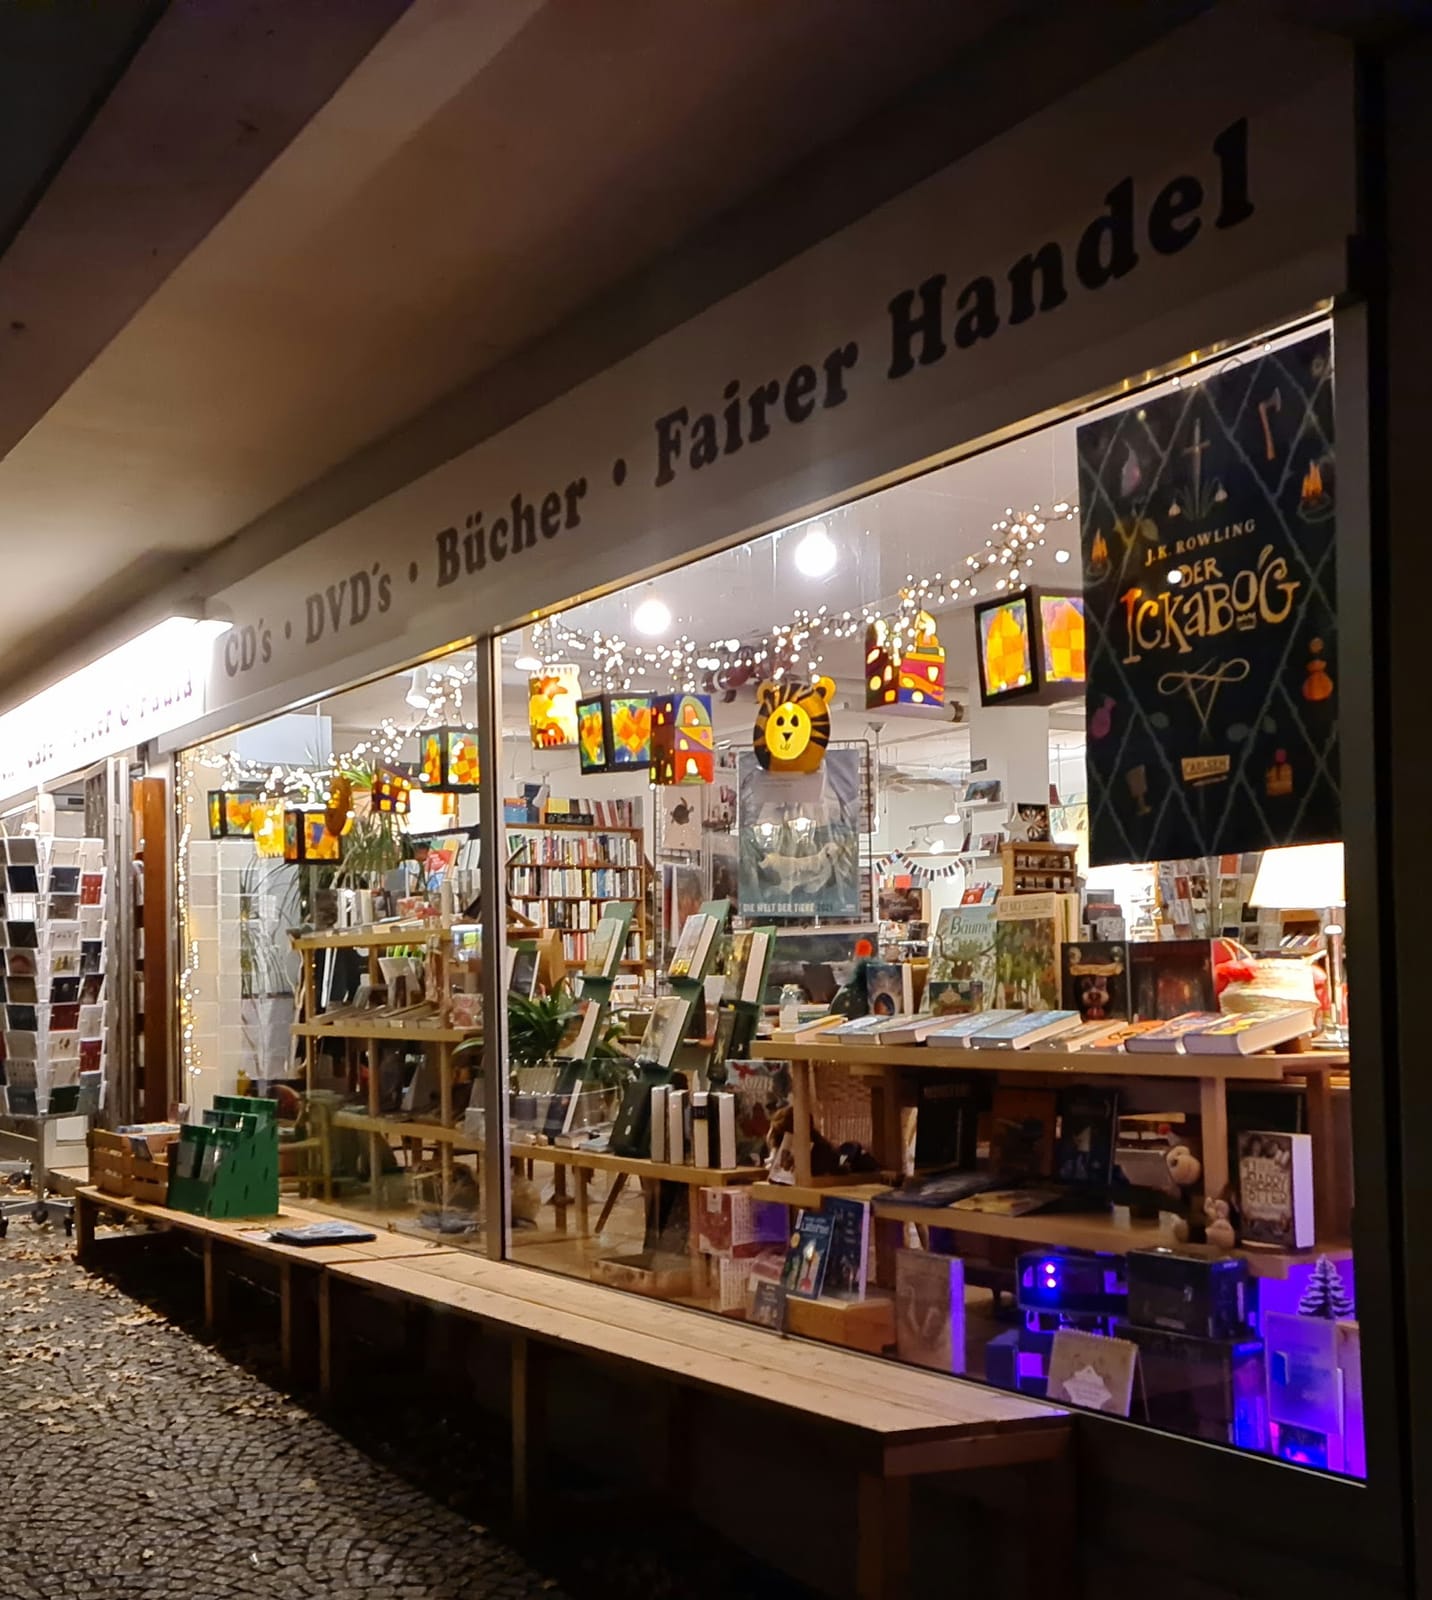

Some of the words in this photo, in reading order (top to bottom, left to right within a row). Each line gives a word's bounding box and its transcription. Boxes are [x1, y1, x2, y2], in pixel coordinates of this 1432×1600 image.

[435, 476, 588, 588] Bücher
[653, 340, 859, 488] Fairer
[886, 117, 1255, 380] Handel
[1175, 518, 1256, 554] ROWLING
[1177, 556, 1223, 588] DER
